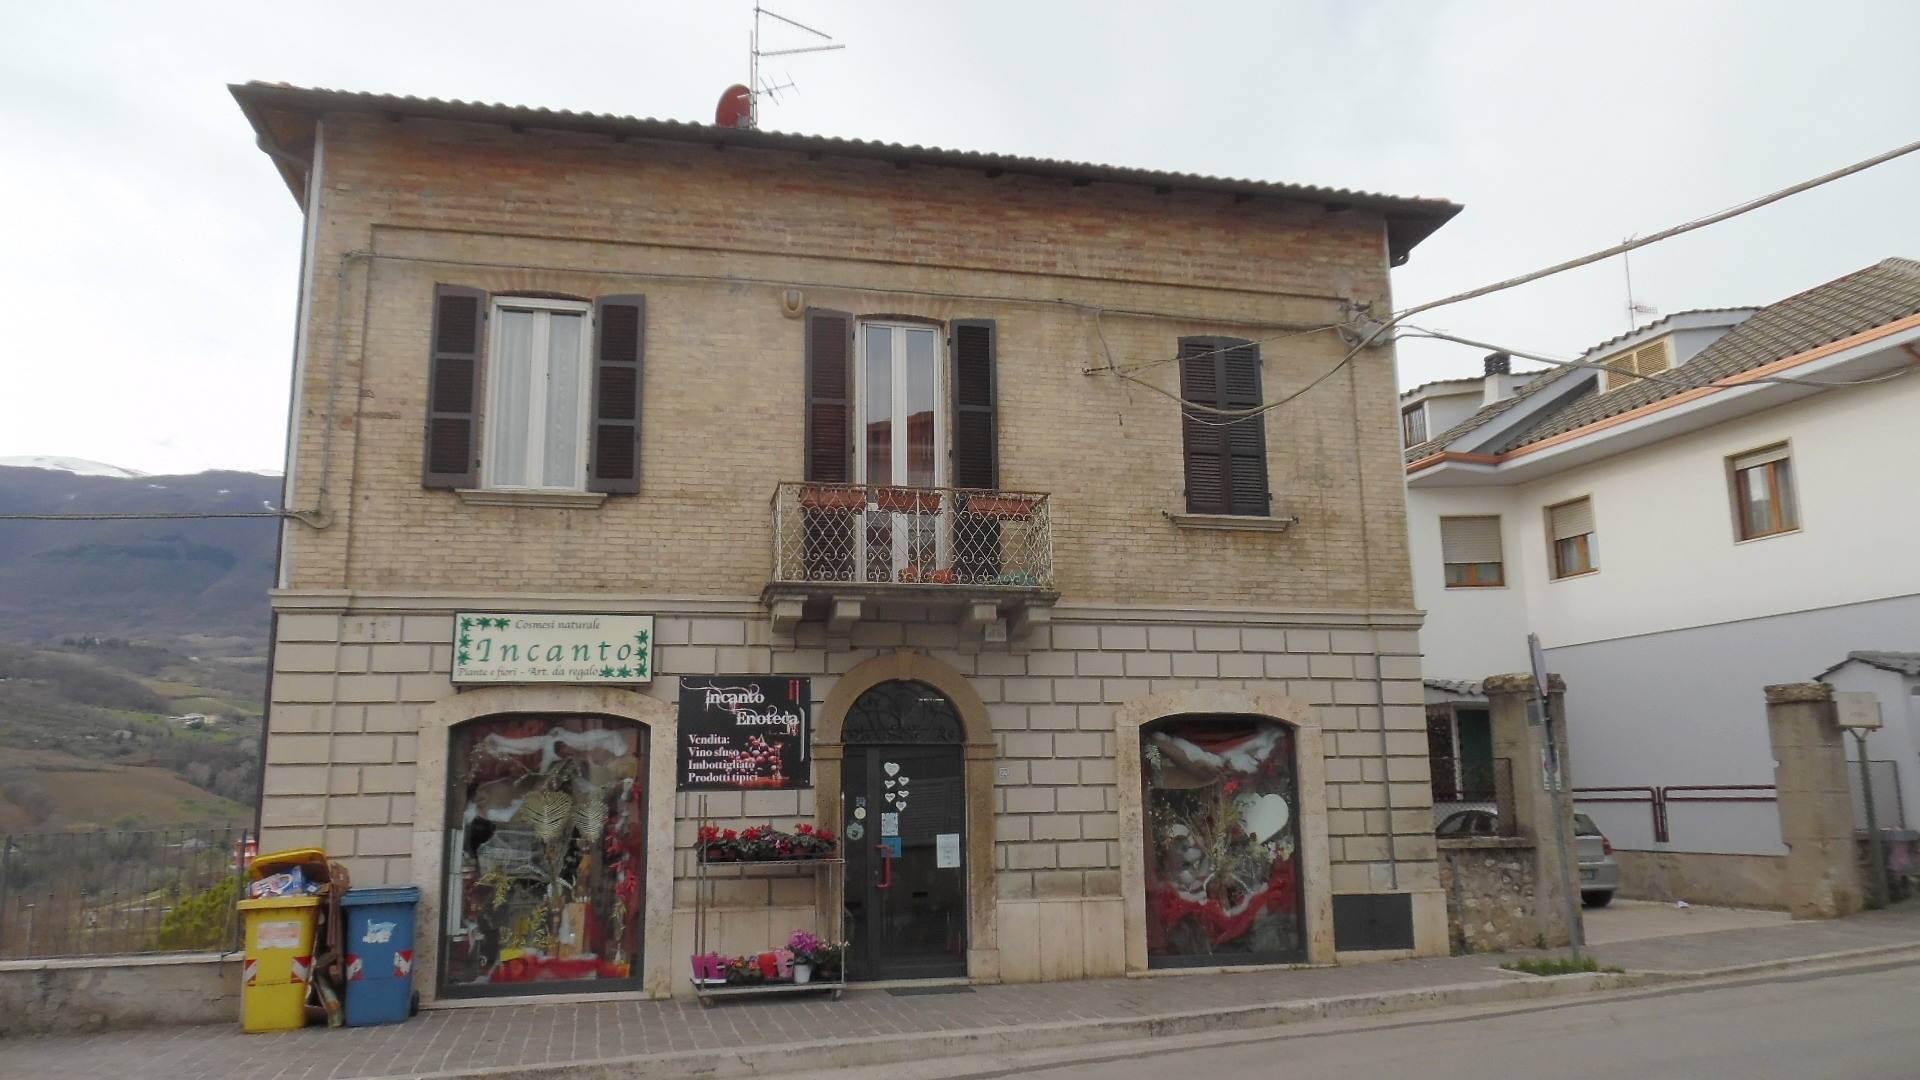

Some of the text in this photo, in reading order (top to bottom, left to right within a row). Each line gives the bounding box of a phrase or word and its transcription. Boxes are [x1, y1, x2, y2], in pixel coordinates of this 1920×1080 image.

[515, 618, 601, 630] Cosmesi naturale
[477, 638, 631, 662] Incanto
[457, 668, 487, 677] Piante
[496, 667, 517, 679] fiori
[552, 664, 565, 676] da
[569, 665, 598, 680] regalo
[736, 710, 800, 727] Enoteca
[688, 733, 730, 745] Vendita:
[688, 746, 740, 757] Vino sfuso
[688, 759, 756, 773] Imbottigliato
[688, 772, 759, 785] Prodotti tipici
